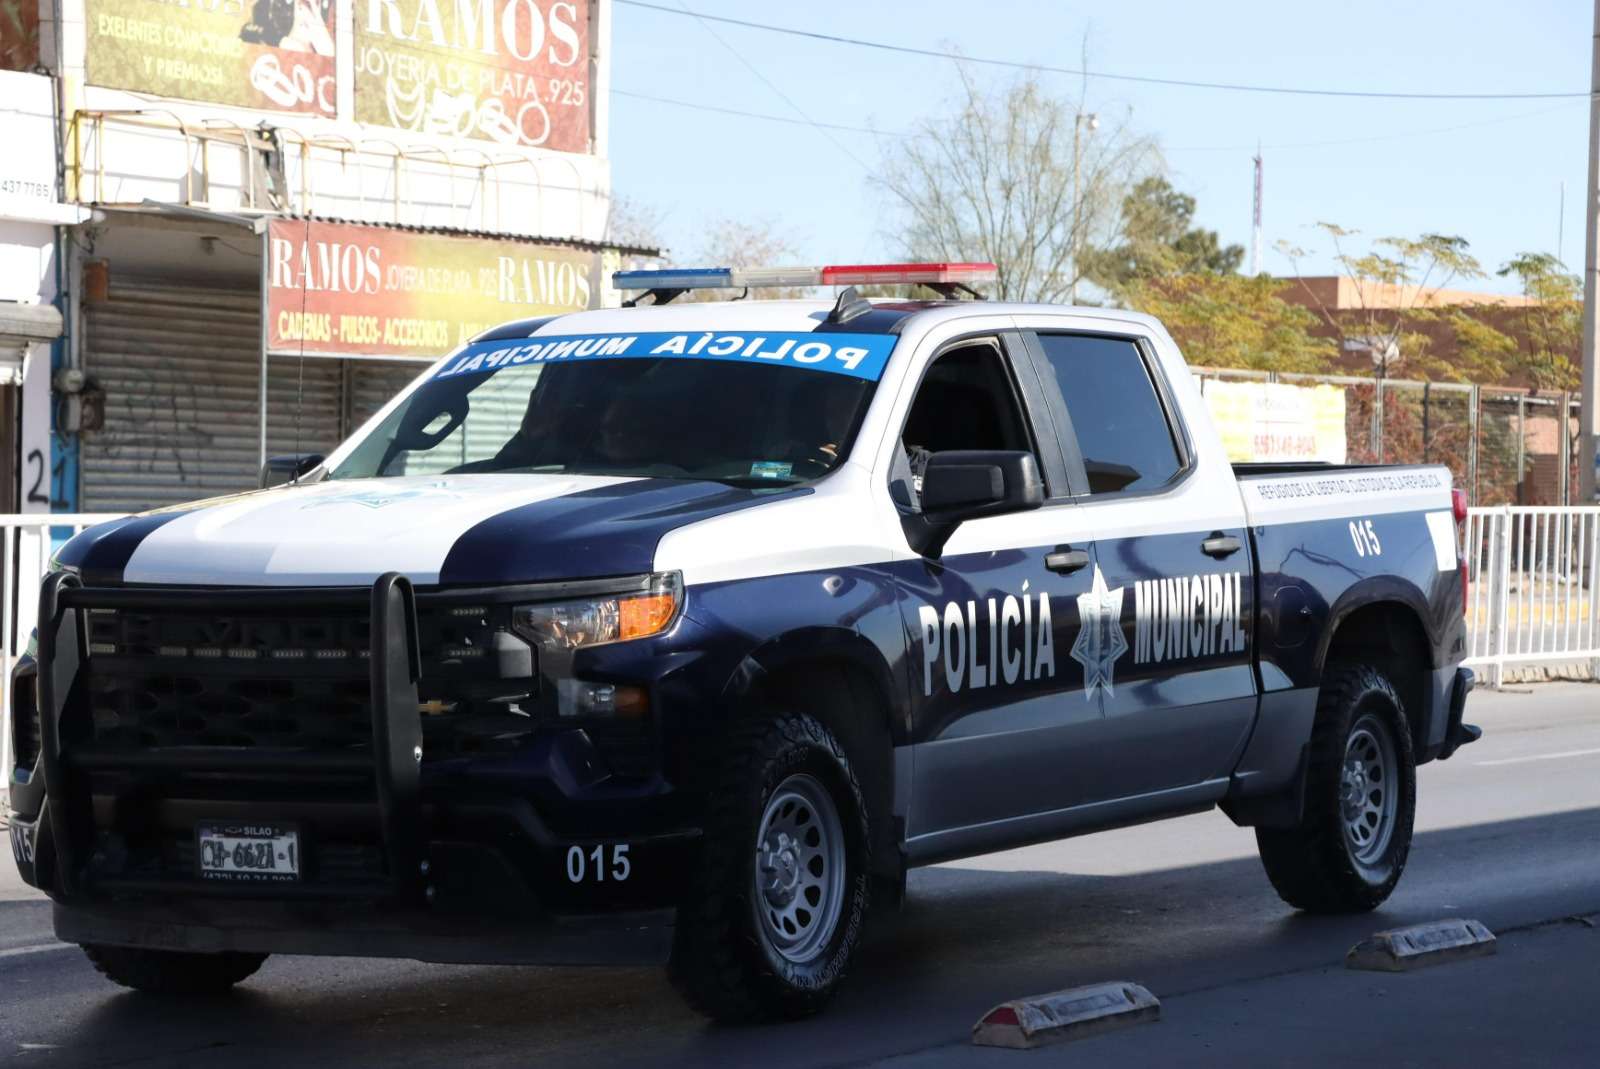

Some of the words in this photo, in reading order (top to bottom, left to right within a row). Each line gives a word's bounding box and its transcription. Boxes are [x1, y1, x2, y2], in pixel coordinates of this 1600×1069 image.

[365, 0, 580, 67] RAMOS
[143, 55, 152, 75] Y
[480, 71, 539, 101] PLATA
[272, 238, 381, 295] RAMOS
[497, 255, 591, 310] RAMOS
[278, 310, 331, 342] CADENAS
[383, 317, 449, 347] ACCESORIOS
[1348, 520, 1382, 557] 015
[918, 578, 1055, 696] POLICÍA
[1134, 571, 1245, 665] MUNICIPAL
[243, 826, 272, 836] SILAO
[567, 844, 631, 883] 015
